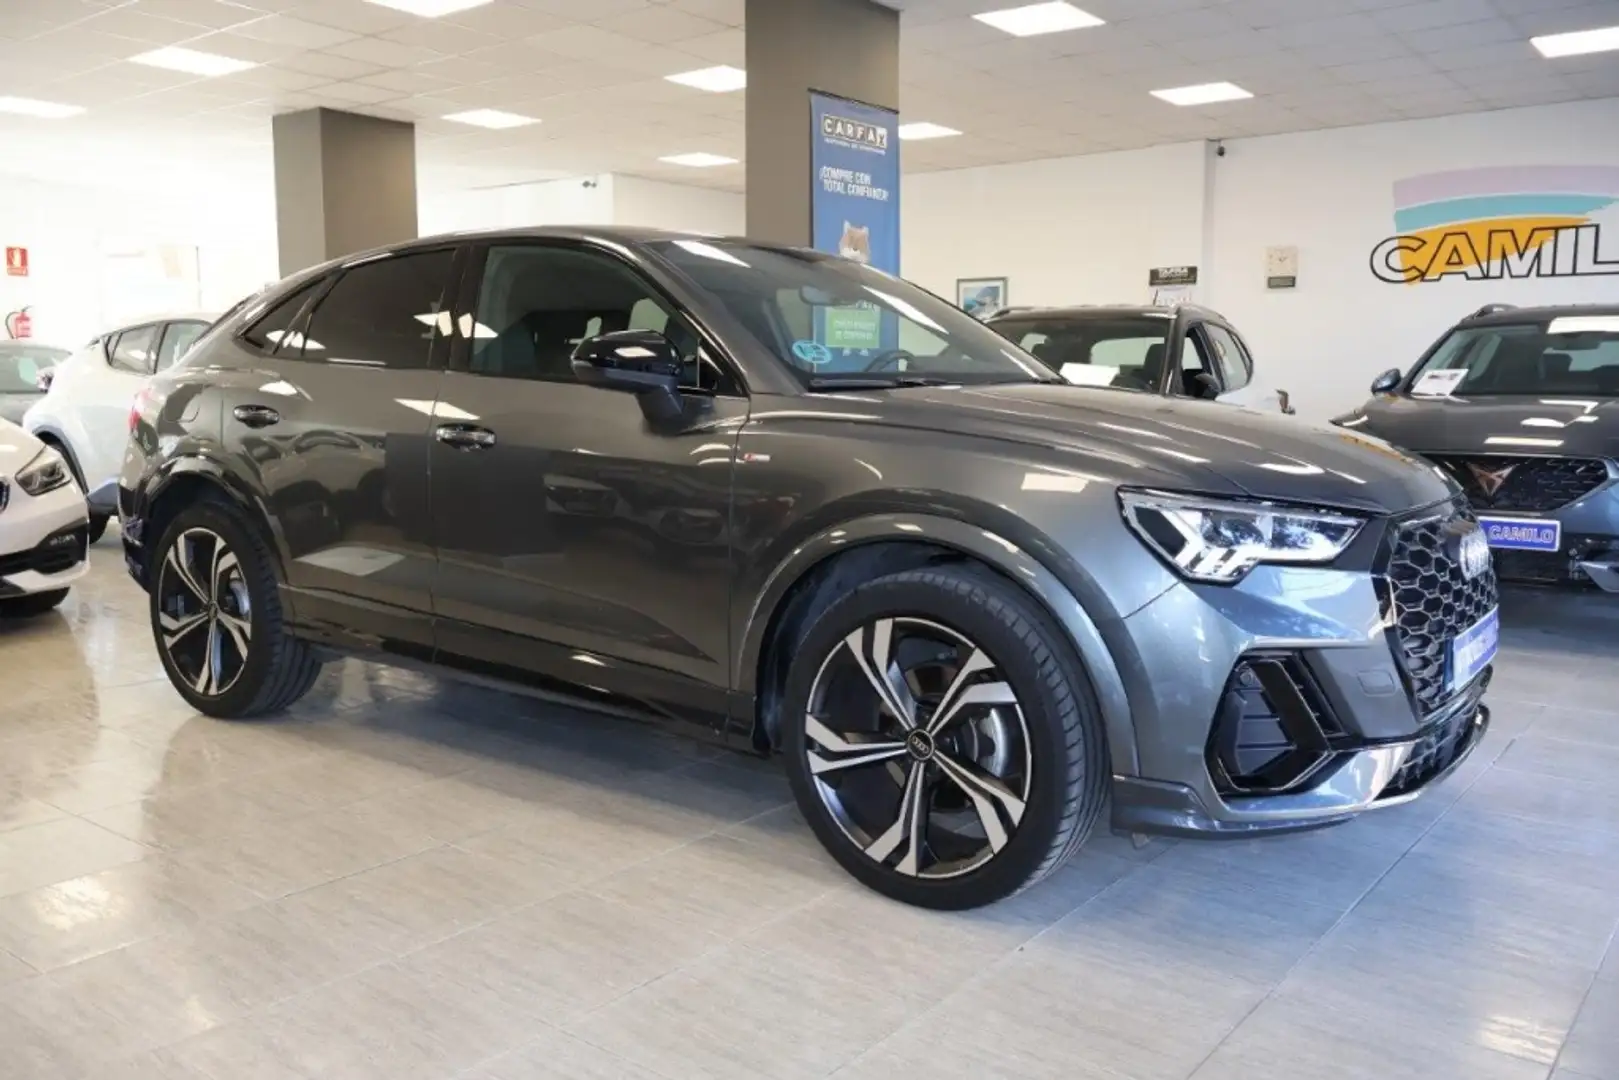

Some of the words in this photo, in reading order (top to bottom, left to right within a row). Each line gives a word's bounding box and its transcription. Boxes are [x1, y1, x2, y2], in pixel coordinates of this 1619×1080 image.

[824, 117, 887, 147] CARFAX
[824, 180, 846, 195] TOTAL
[1488, 525, 1554, 543] CAMILO
